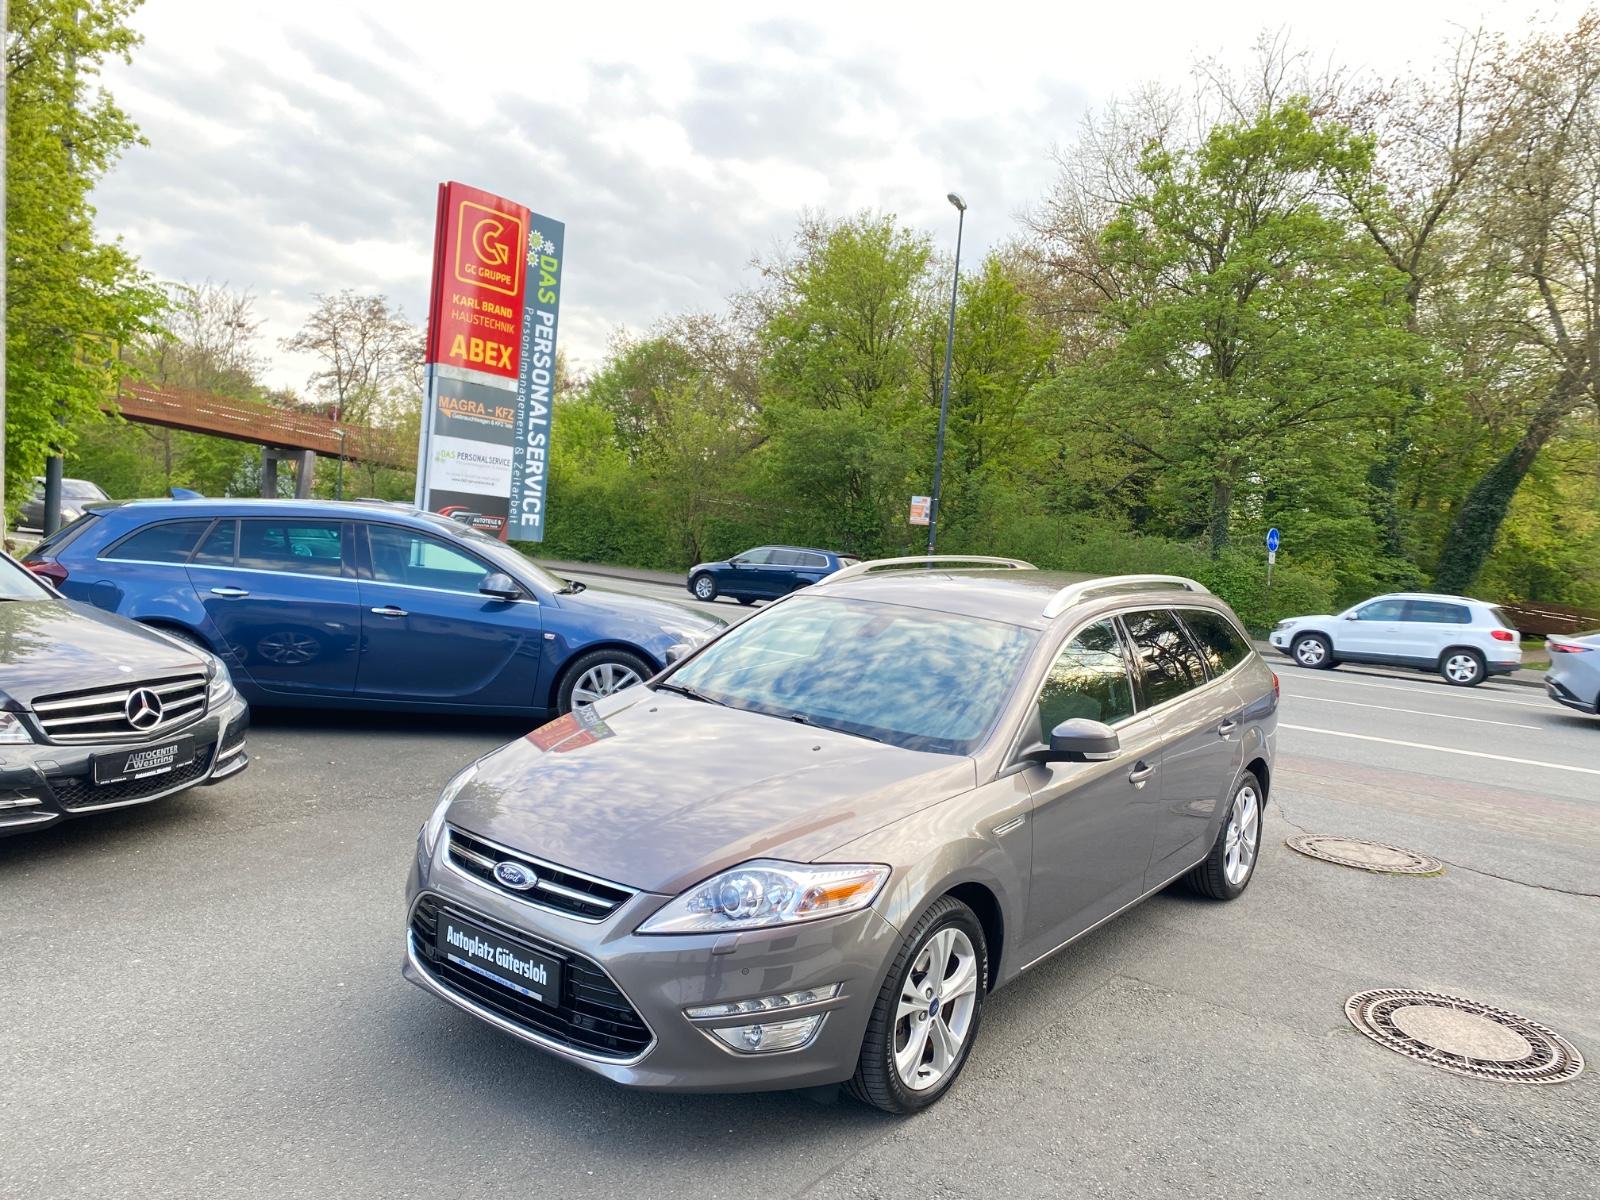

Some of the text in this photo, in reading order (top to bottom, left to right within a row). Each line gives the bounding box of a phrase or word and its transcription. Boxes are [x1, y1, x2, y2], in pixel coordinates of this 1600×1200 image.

[464, 263, 513, 285] GC GRUPPE
[452, 293, 513, 319] KARL BRAND
[451, 308, 516, 335] HAUSTECHNIK
[449, 334, 513, 370] ABEX
[521, 255, 558, 527] DAS PERSONALSERVICE
[438, 395, 485, 415] MAGRA
[495, 406, 514, 420] KFZ
[509, 306, 534, 525] Personalmanagement & Zeitarbeit
[440, 450, 456, 460] DAS
[457, 451, 511, 467] PERSONALSERVICE
[125, 745, 178, 769] AUTOCENTER
[134, 754, 174, 769] Westring
[446, 925, 494, 963] Autoplatz
[495, 947, 547, 986] Gütersloh
